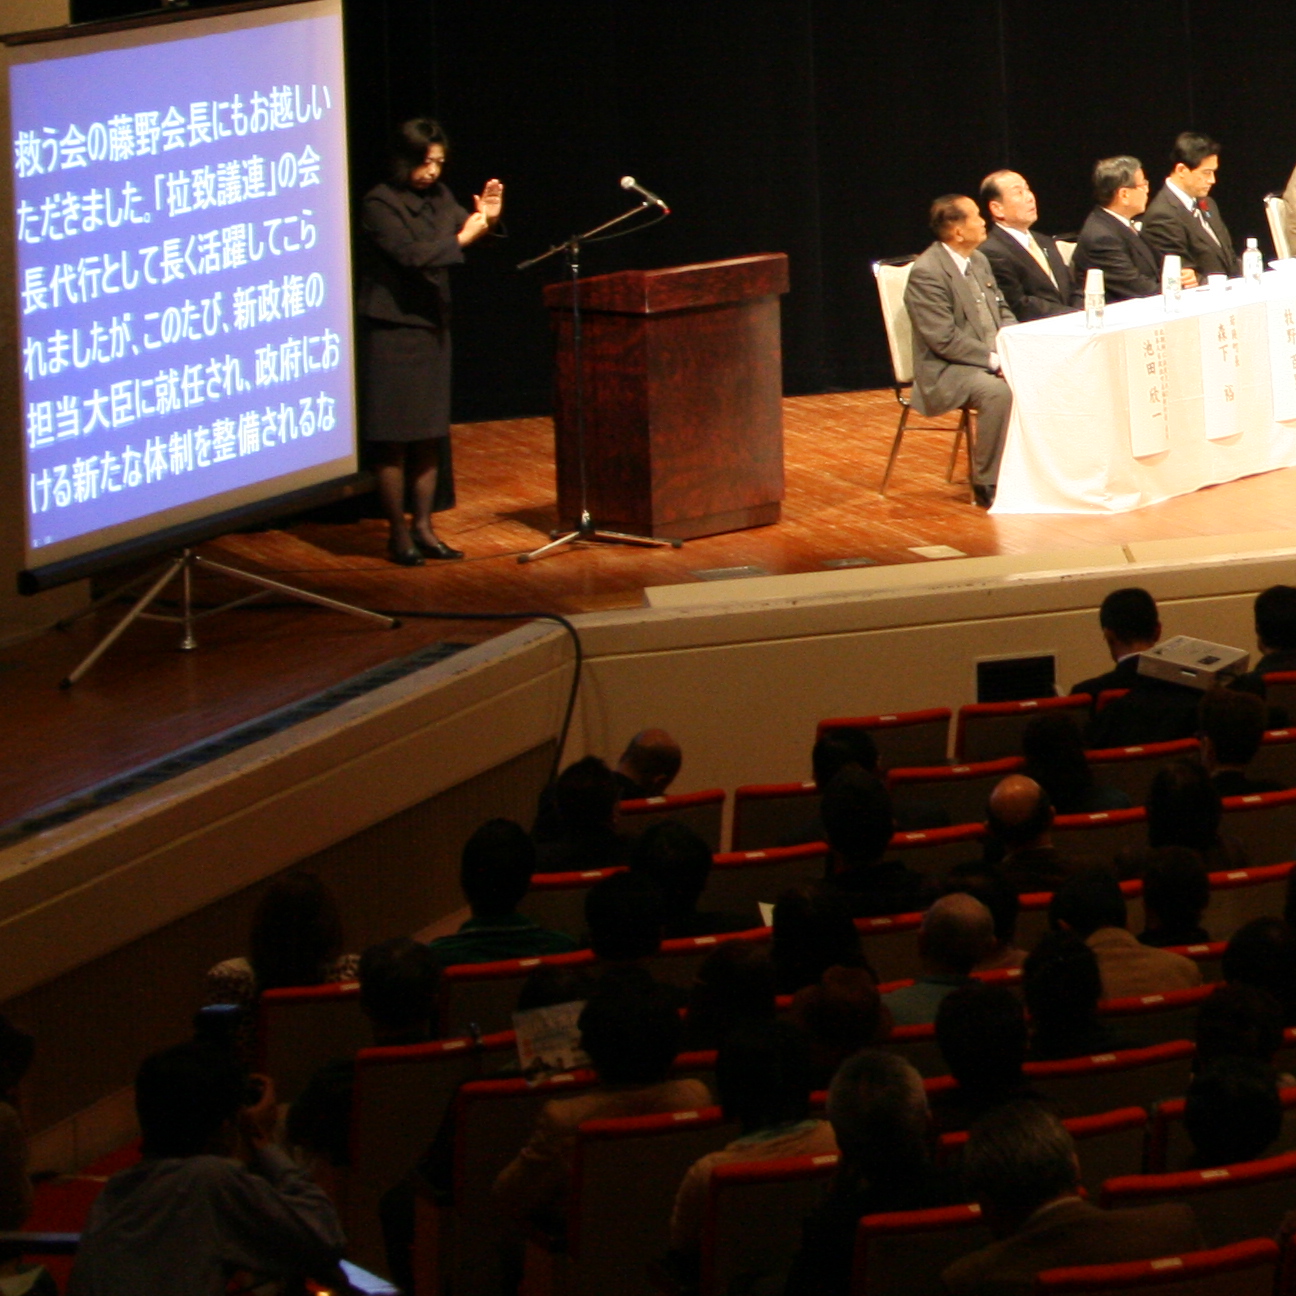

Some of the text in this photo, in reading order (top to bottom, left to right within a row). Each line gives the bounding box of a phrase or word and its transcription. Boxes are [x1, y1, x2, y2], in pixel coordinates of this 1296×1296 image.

[14, 84, 334, 179] 救う会の藤野会長にもお越しい
[17, 144, 321, 244] ただきました。「拉致議連」の会
[21, 209, 317, 314] 長代行として長く活躍してこら
[24, 271, 325, 381] れましたが、このたび、新政権の
[27, 329, 340, 448] 担当大臣に就任され、政府にお
[30, 390, 337, 514] ける新たな体制を整備されるな
